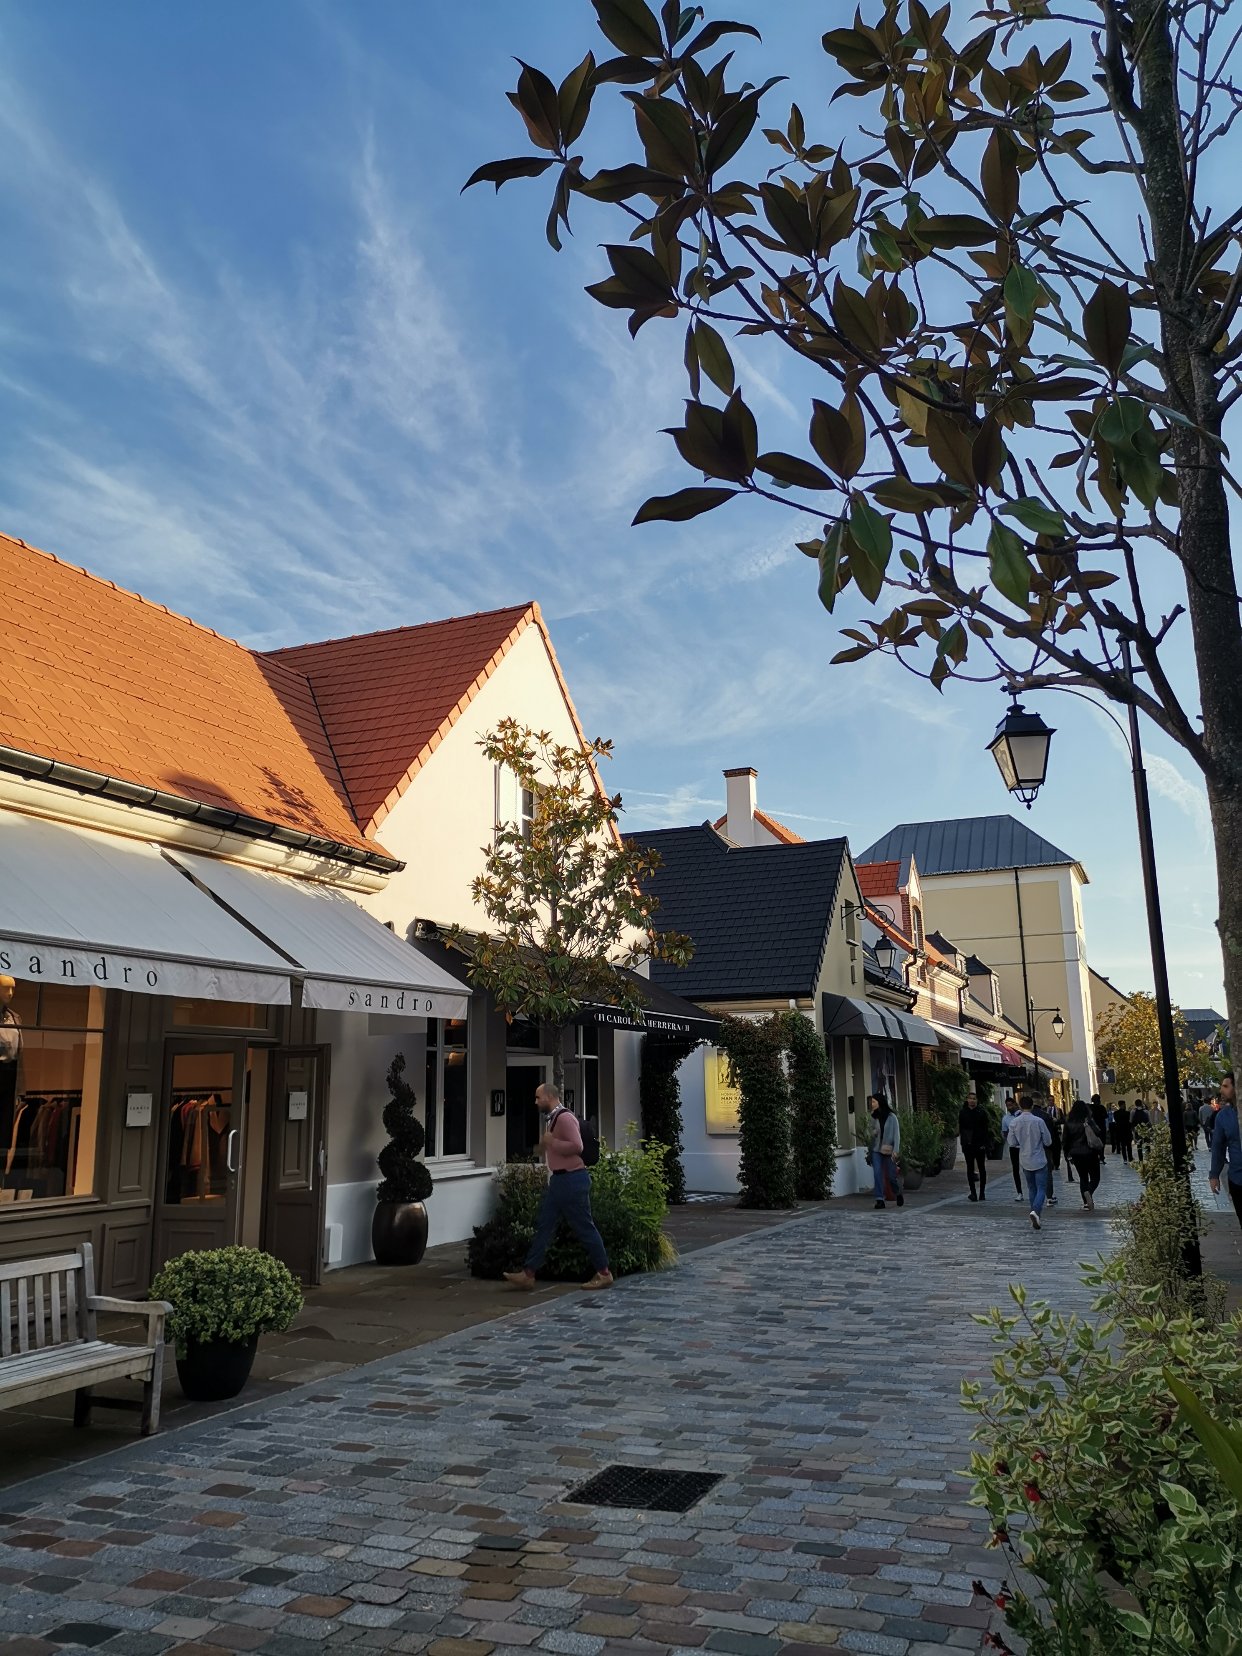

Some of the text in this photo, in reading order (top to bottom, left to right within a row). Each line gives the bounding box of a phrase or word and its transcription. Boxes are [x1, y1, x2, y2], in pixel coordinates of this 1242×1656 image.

[0, 951, 158, 987] sandro
[348, 991, 433, 1012] sandro
[647, 1019, 681, 1032] HERRERA
